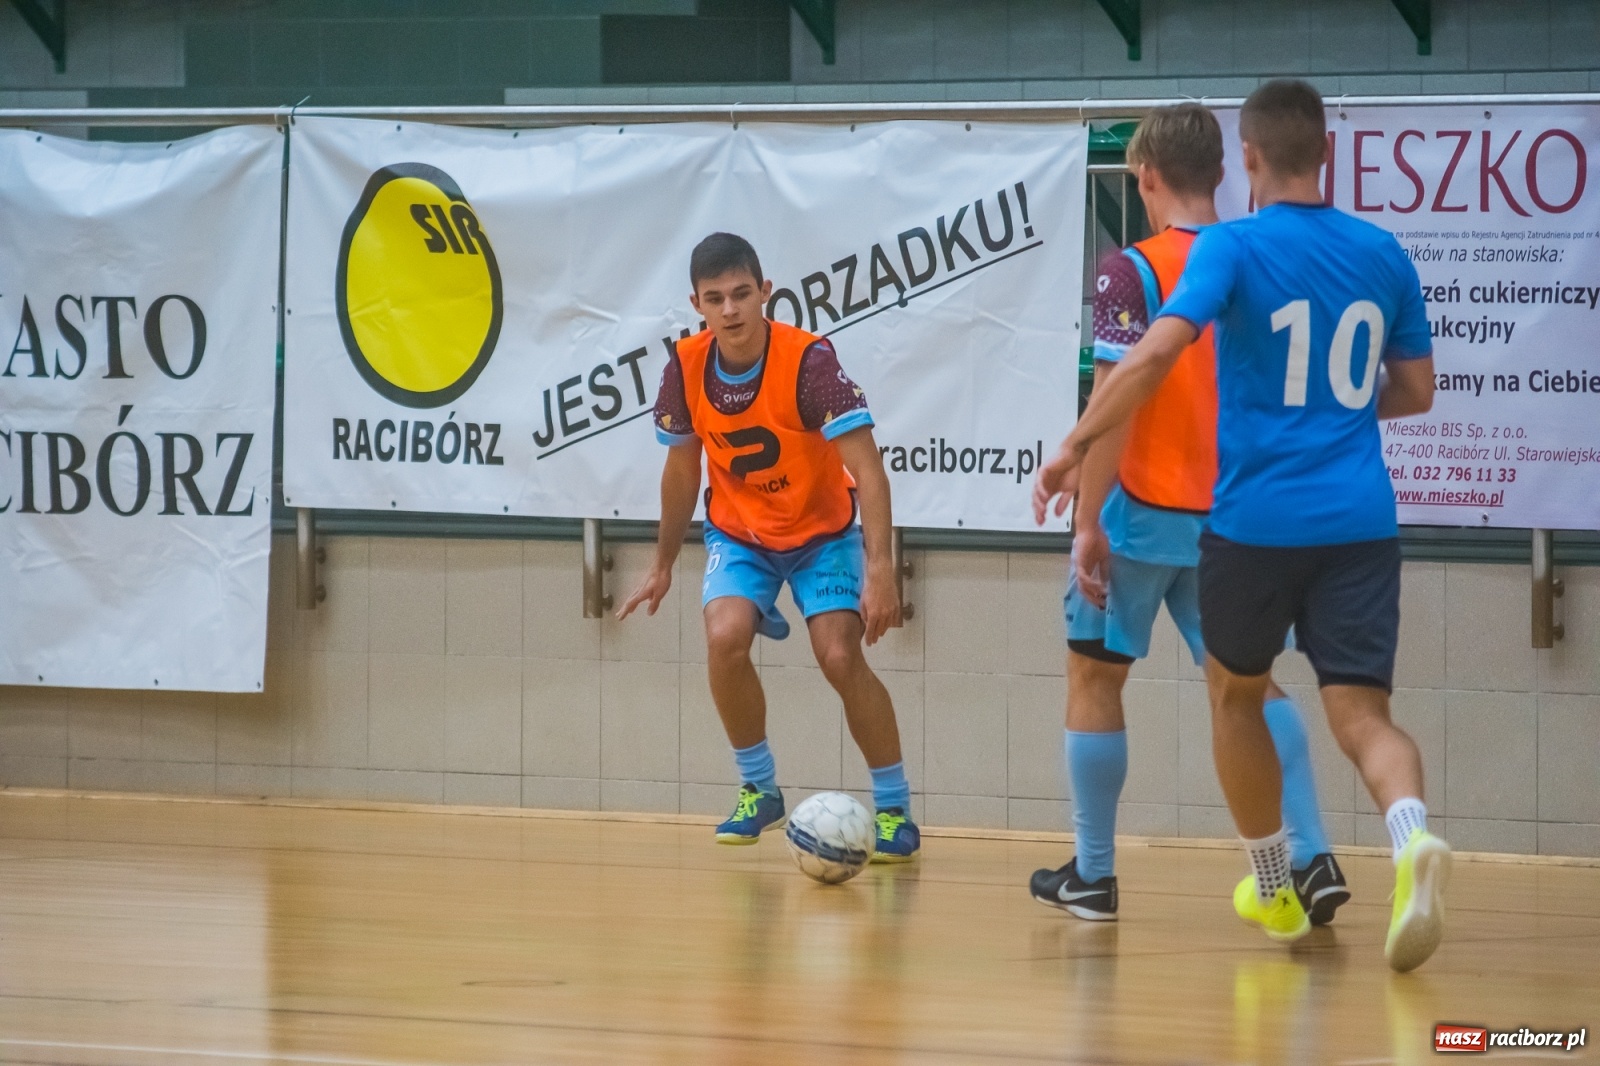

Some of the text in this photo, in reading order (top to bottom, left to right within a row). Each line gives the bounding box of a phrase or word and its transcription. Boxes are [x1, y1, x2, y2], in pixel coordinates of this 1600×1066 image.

[1248, 128, 1588, 217] IESZKO
[410, 203, 483, 254] SIR
[1395, 231, 1404, 239] na
[1406, 230, 1439, 240] podstawie
[1441, 231, 1460, 240] wpisu
[1462, 231, 1470, 239] do
[1472, 231, 1499, 240] Rejestru
[1501, 231, 1526, 240] Agencji
[1528, 231, 1571, 240] Zatrudnienia
[1573, 230, 1584, 240] pod
[1449, 248, 1467, 262] na
[1473, 244, 1565, 263] stanowiska:
[1422, 278, 1600, 310] zeń cukierniczy
[532, 181, 1035, 447] JEST ORZĄDKU!
[1427, 315, 1516, 344] ukcyjny
[0, 293, 207, 380] ASTO
[1270, 299, 1384, 410] 10
[1494, 373, 1520, 392] na
[1529, 369, 1600, 393] Ciebie
[333, 411, 504, 465] RACIBÓRZ
[1386, 421, 1528, 441] Mieszko BIS Sp. z o.o.
[0, 405, 254, 517] IBÓRZ
[1386, 443, 1600, 466] 47-400 Racibórz Ul. Starowiejska
[1386, 465, 1517, 483] tel. 032 796 11 33
